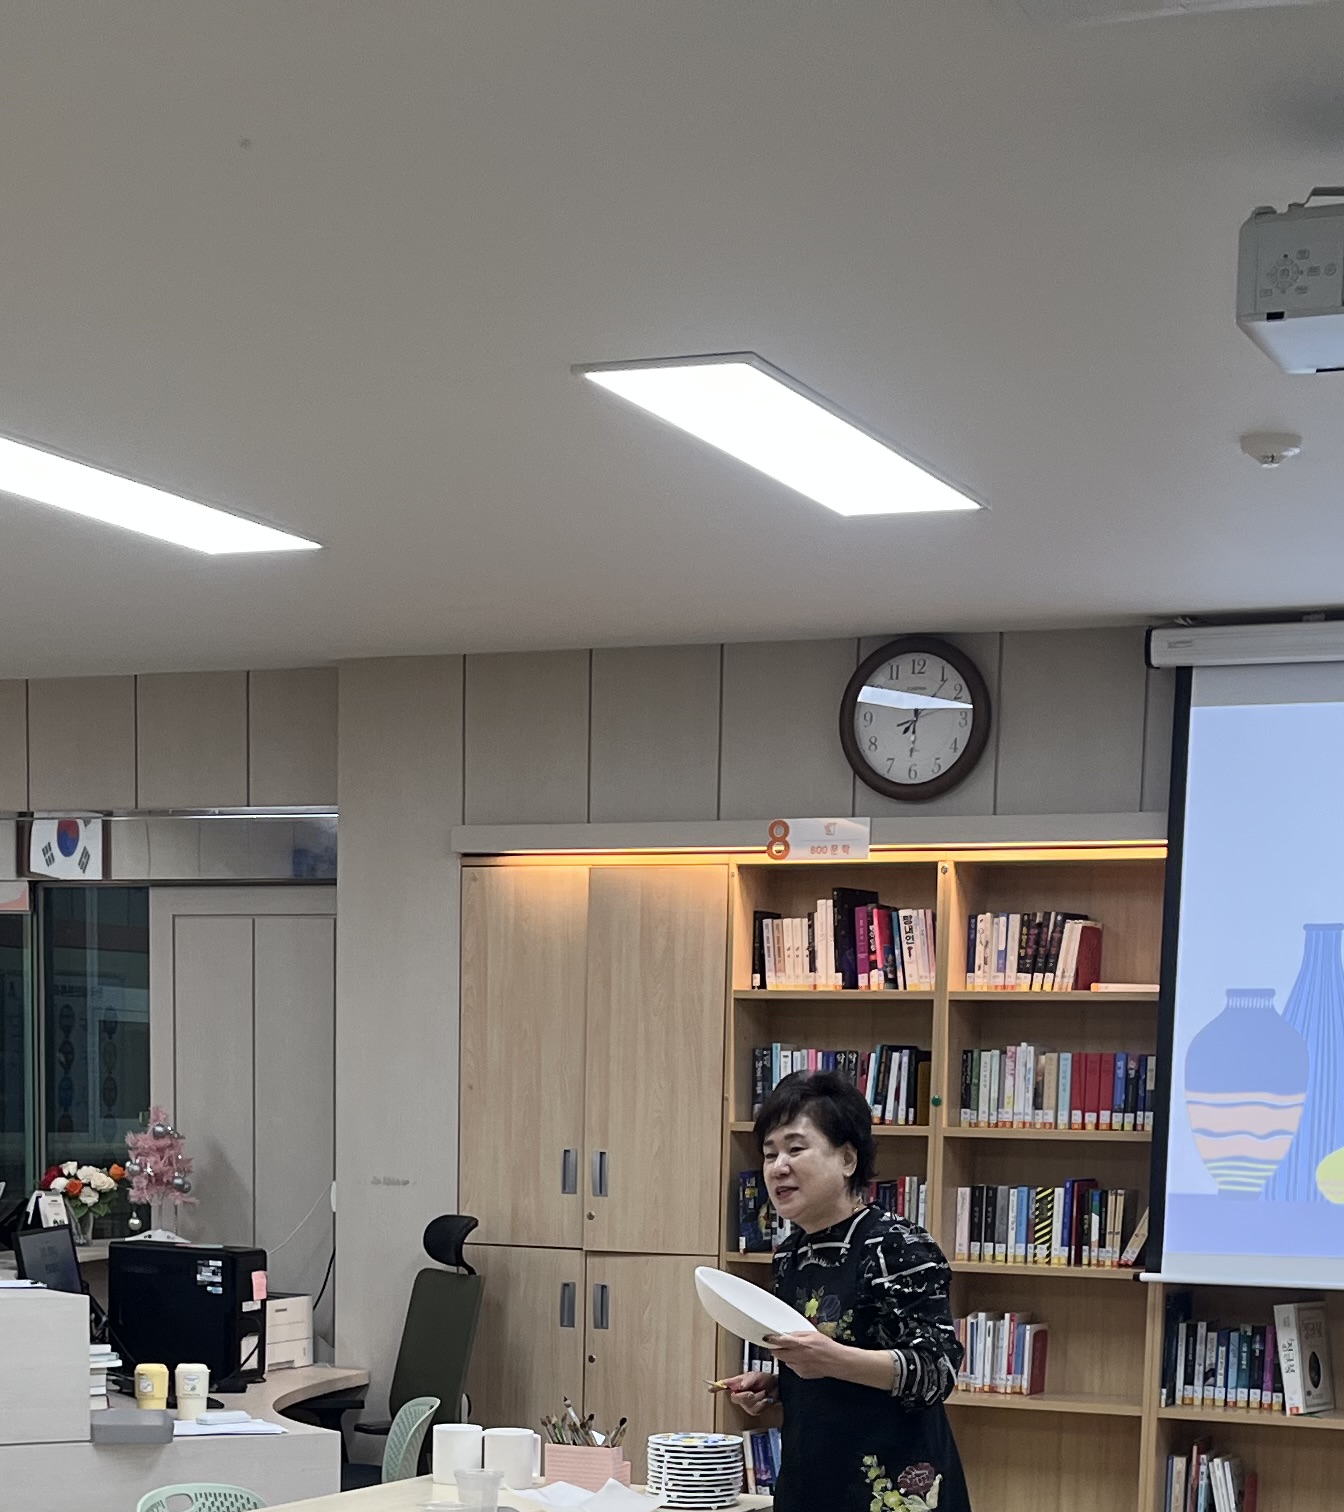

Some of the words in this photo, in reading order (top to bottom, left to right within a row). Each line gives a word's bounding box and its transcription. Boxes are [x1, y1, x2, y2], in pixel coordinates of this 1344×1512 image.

[888, 664, 900, 681] 11
[911, 657, 927, 675] 12
[953, 683, 963, 700] 2
[863, 710, 874, 728] 9
[958, 711, 968, 728] 3
[868, 735, 878, 752] 8
[949, 736, 959, 753] 4
[886, 757, 895, 774] 7
[908, 763, 918, 780] 6
[931, 757, 942, 774] 5
[766, 819, 790, 861] 8
[810, 845, 828, 855] 800
[902, 914, 915, 945] 망내인
